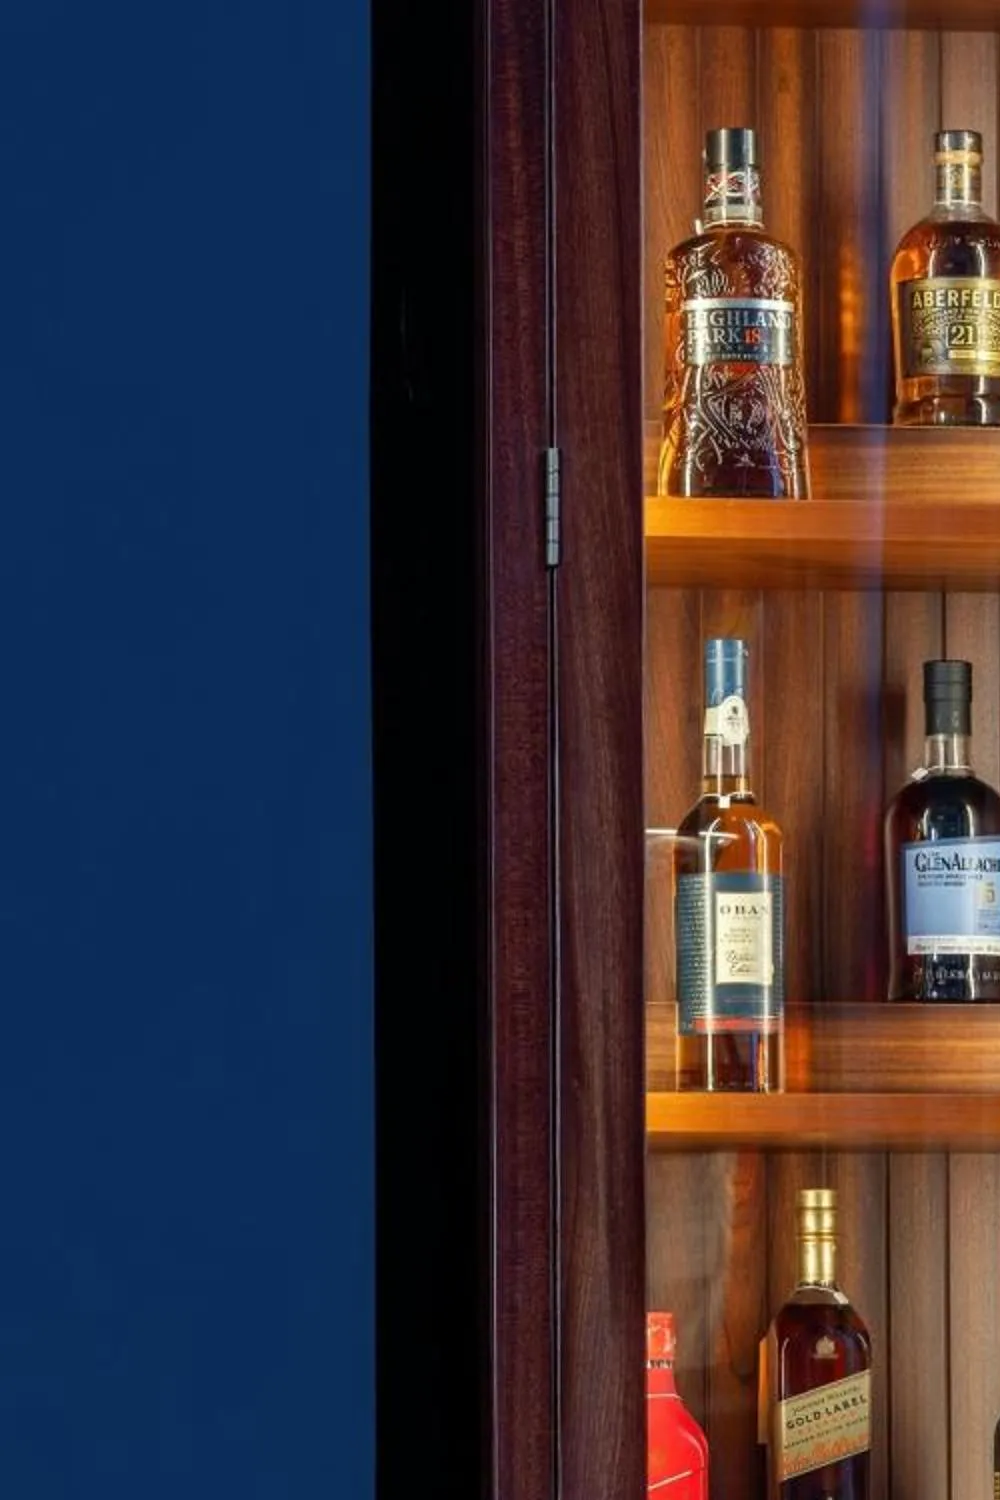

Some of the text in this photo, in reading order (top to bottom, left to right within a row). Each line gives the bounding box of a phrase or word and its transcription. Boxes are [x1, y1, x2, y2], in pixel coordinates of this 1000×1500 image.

[687, 309, 791, 329] HIGHLAND
[687, 327, 761, 345] PARK 18
[951, 325, 975, 345] 21
[786, 1411, 821, 1429] GOLD
[825, 1394, 867, 1416] LABEL
